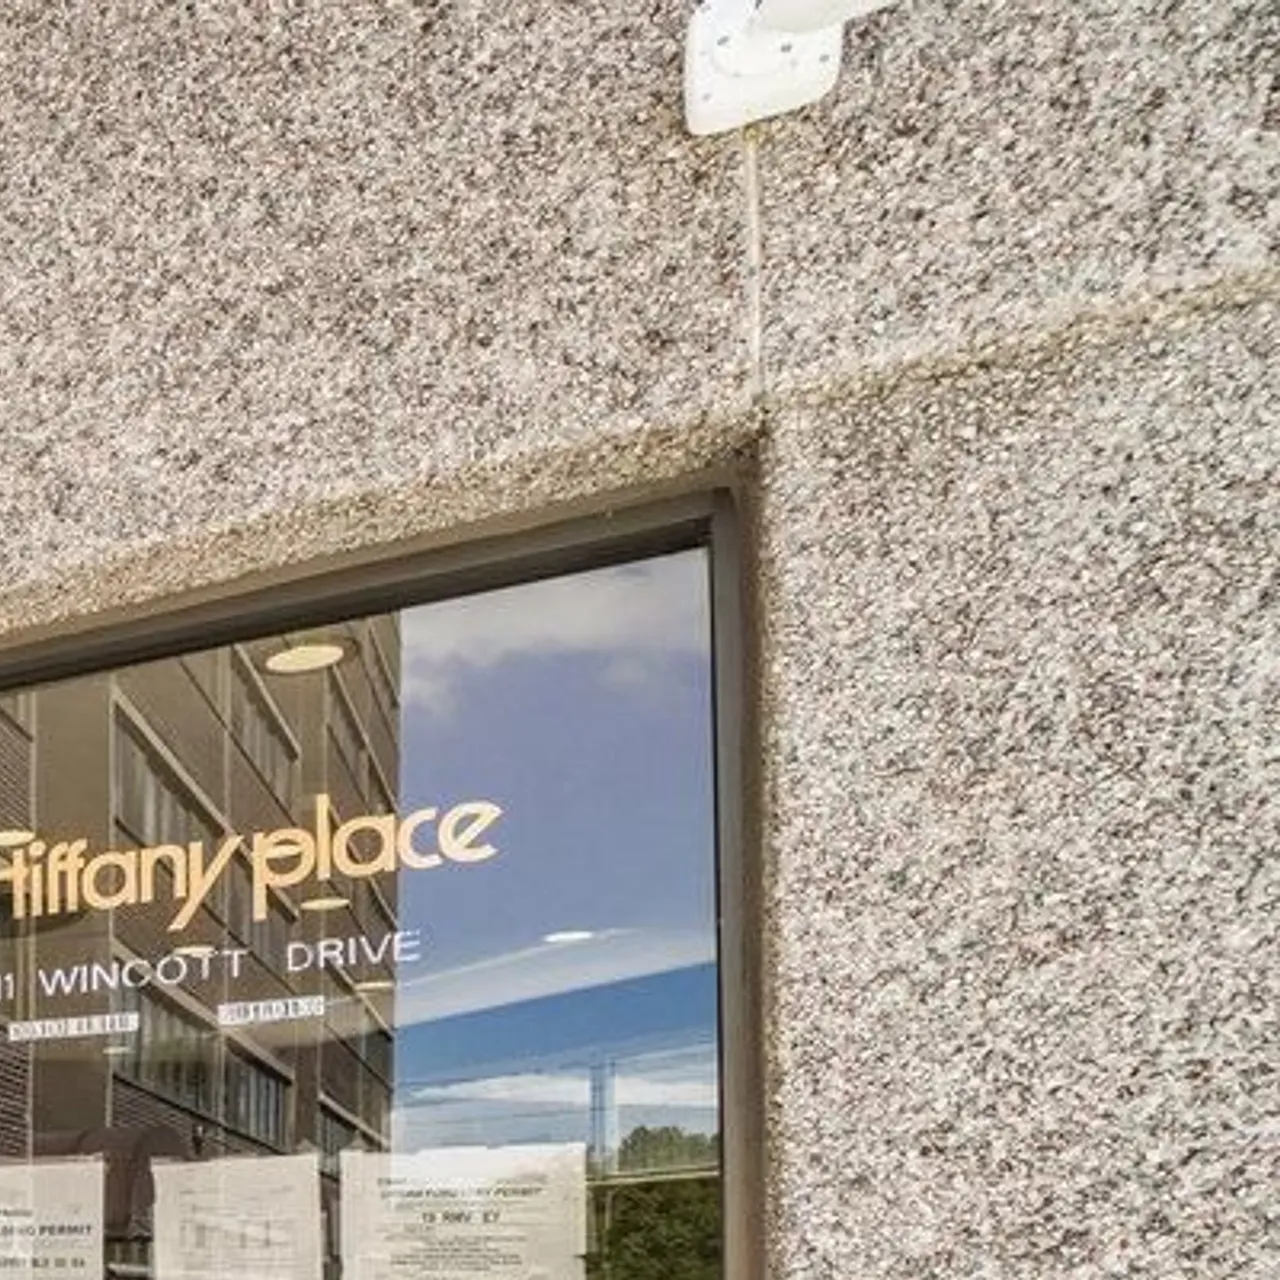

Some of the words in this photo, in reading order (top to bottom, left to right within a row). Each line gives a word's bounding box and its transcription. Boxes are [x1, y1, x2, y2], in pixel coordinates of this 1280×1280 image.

[253, 794, 502, 922] place
[39, 949, 248, 996] WINCOTT
[286, 931, 421, 973] DRIVE
[39, 1223, 91, 1236] PERMIT
